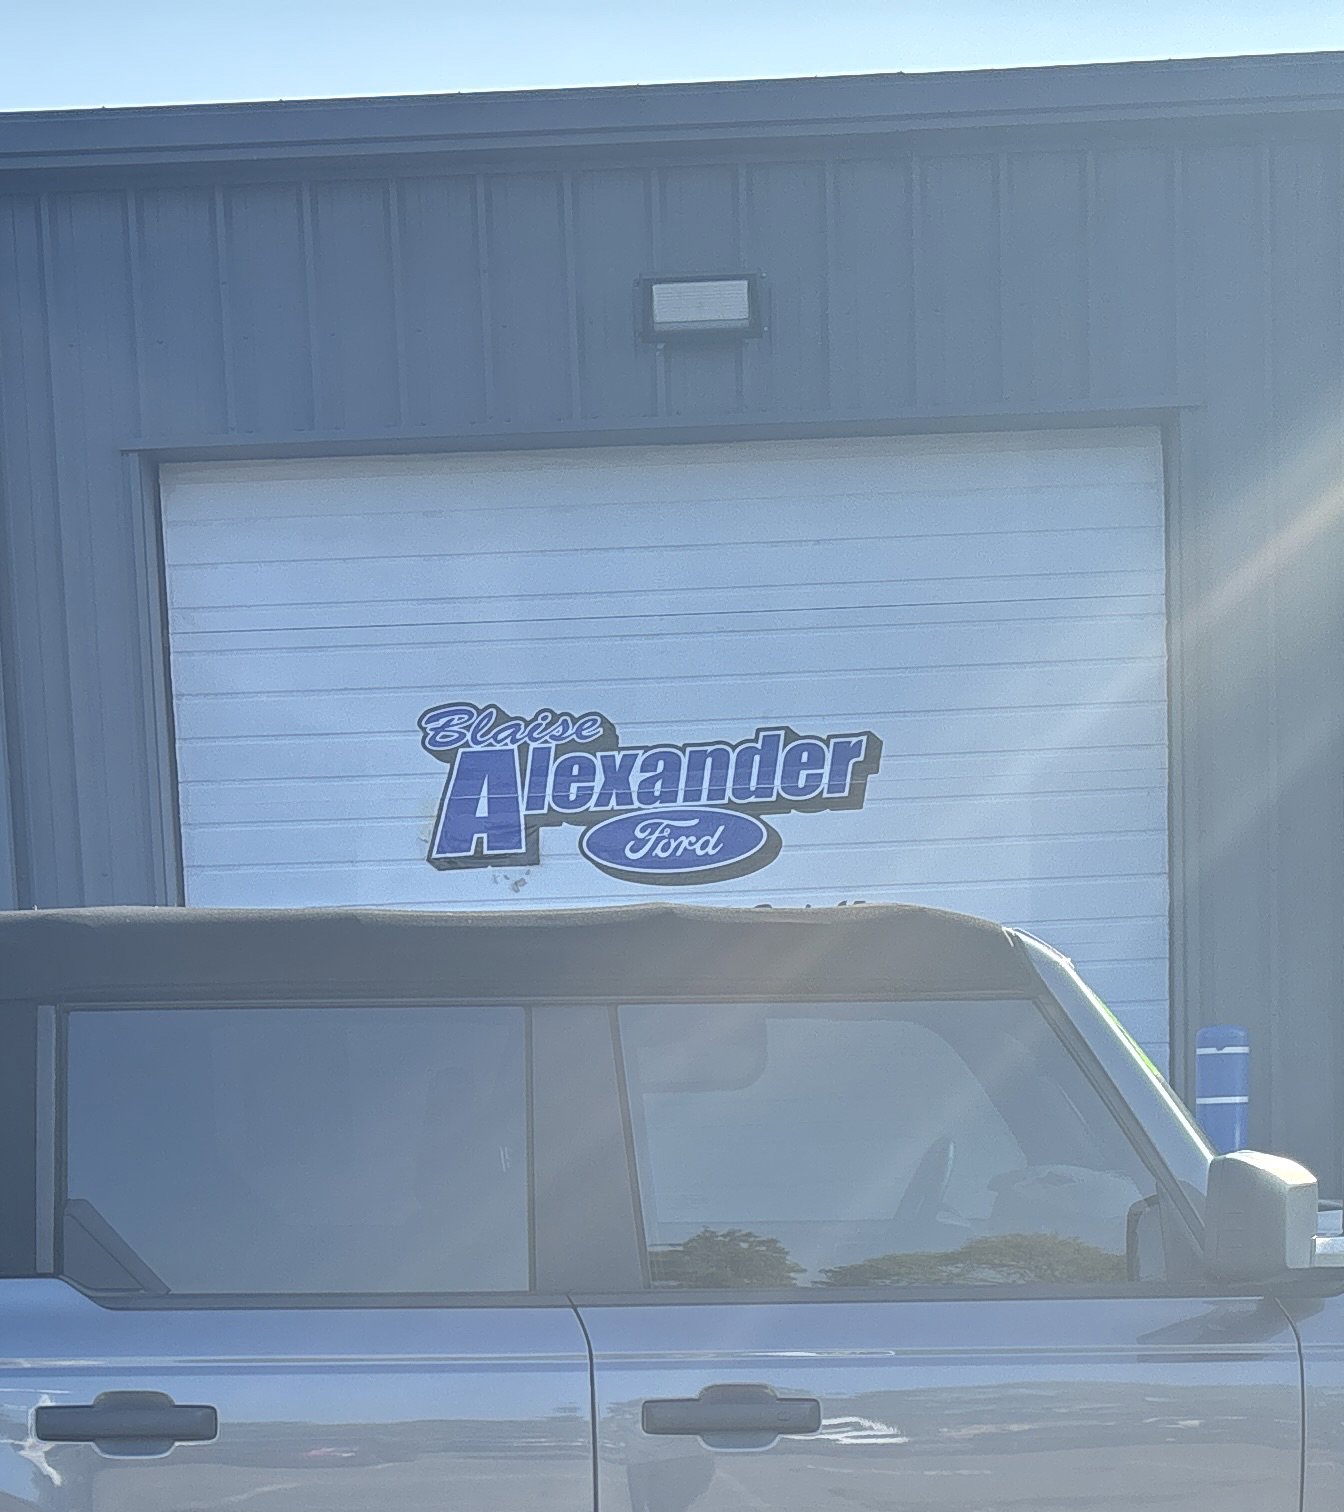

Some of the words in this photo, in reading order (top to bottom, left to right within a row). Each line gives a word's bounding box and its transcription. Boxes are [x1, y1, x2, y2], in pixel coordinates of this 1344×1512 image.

[422, 705, 604, 750] Blaise
[432, 730, 867, 859] Alexander
[625, 817, 726, 860] Ford
